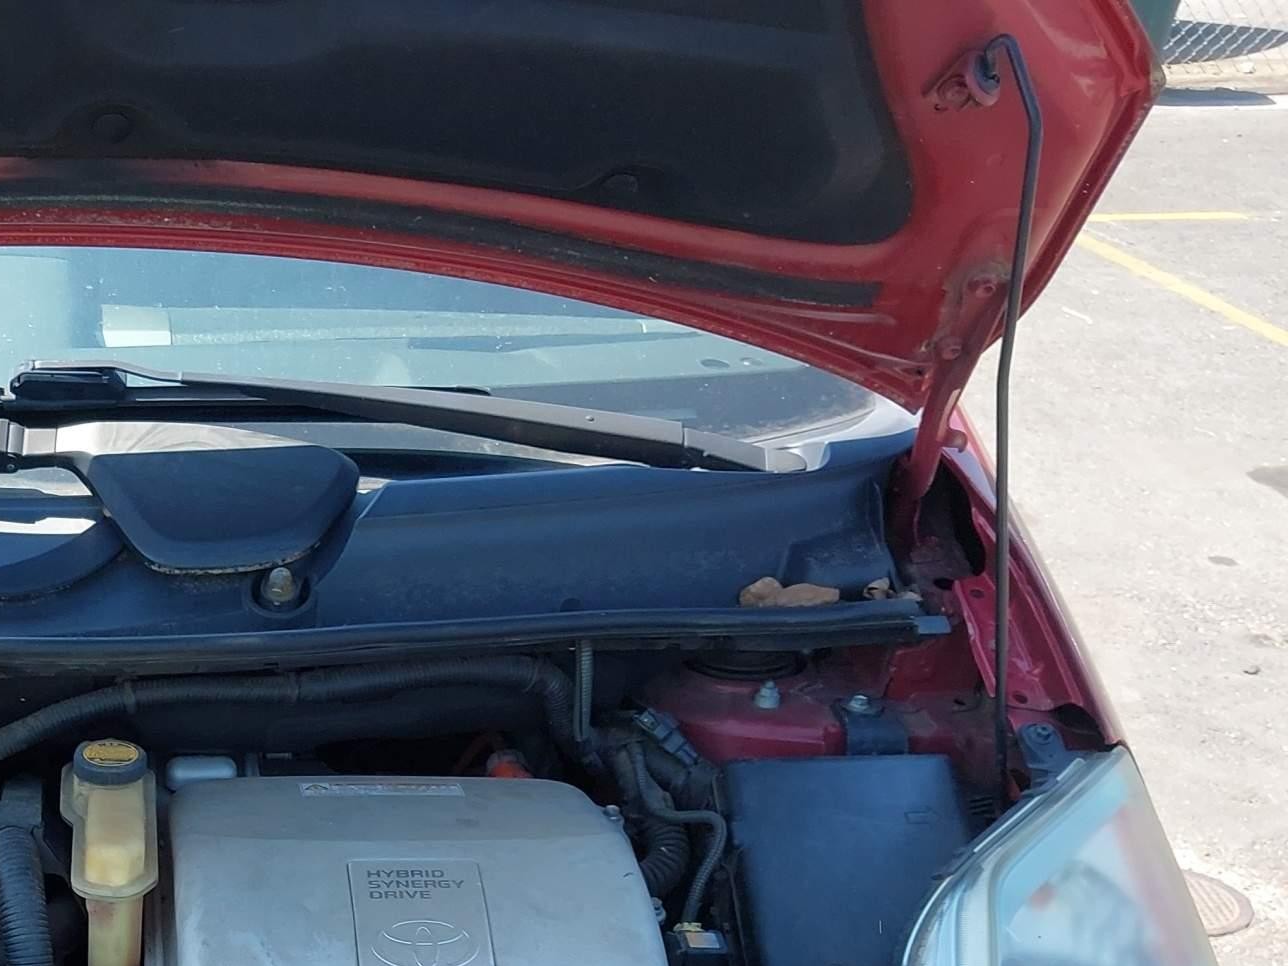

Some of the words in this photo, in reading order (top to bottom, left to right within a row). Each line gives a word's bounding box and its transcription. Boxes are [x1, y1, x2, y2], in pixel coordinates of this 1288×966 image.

[367, 869, 445, 878] HYBRID
[368, 880, 465, 889] SYNERGY
[369, 890, 432, 900] DRIVE
